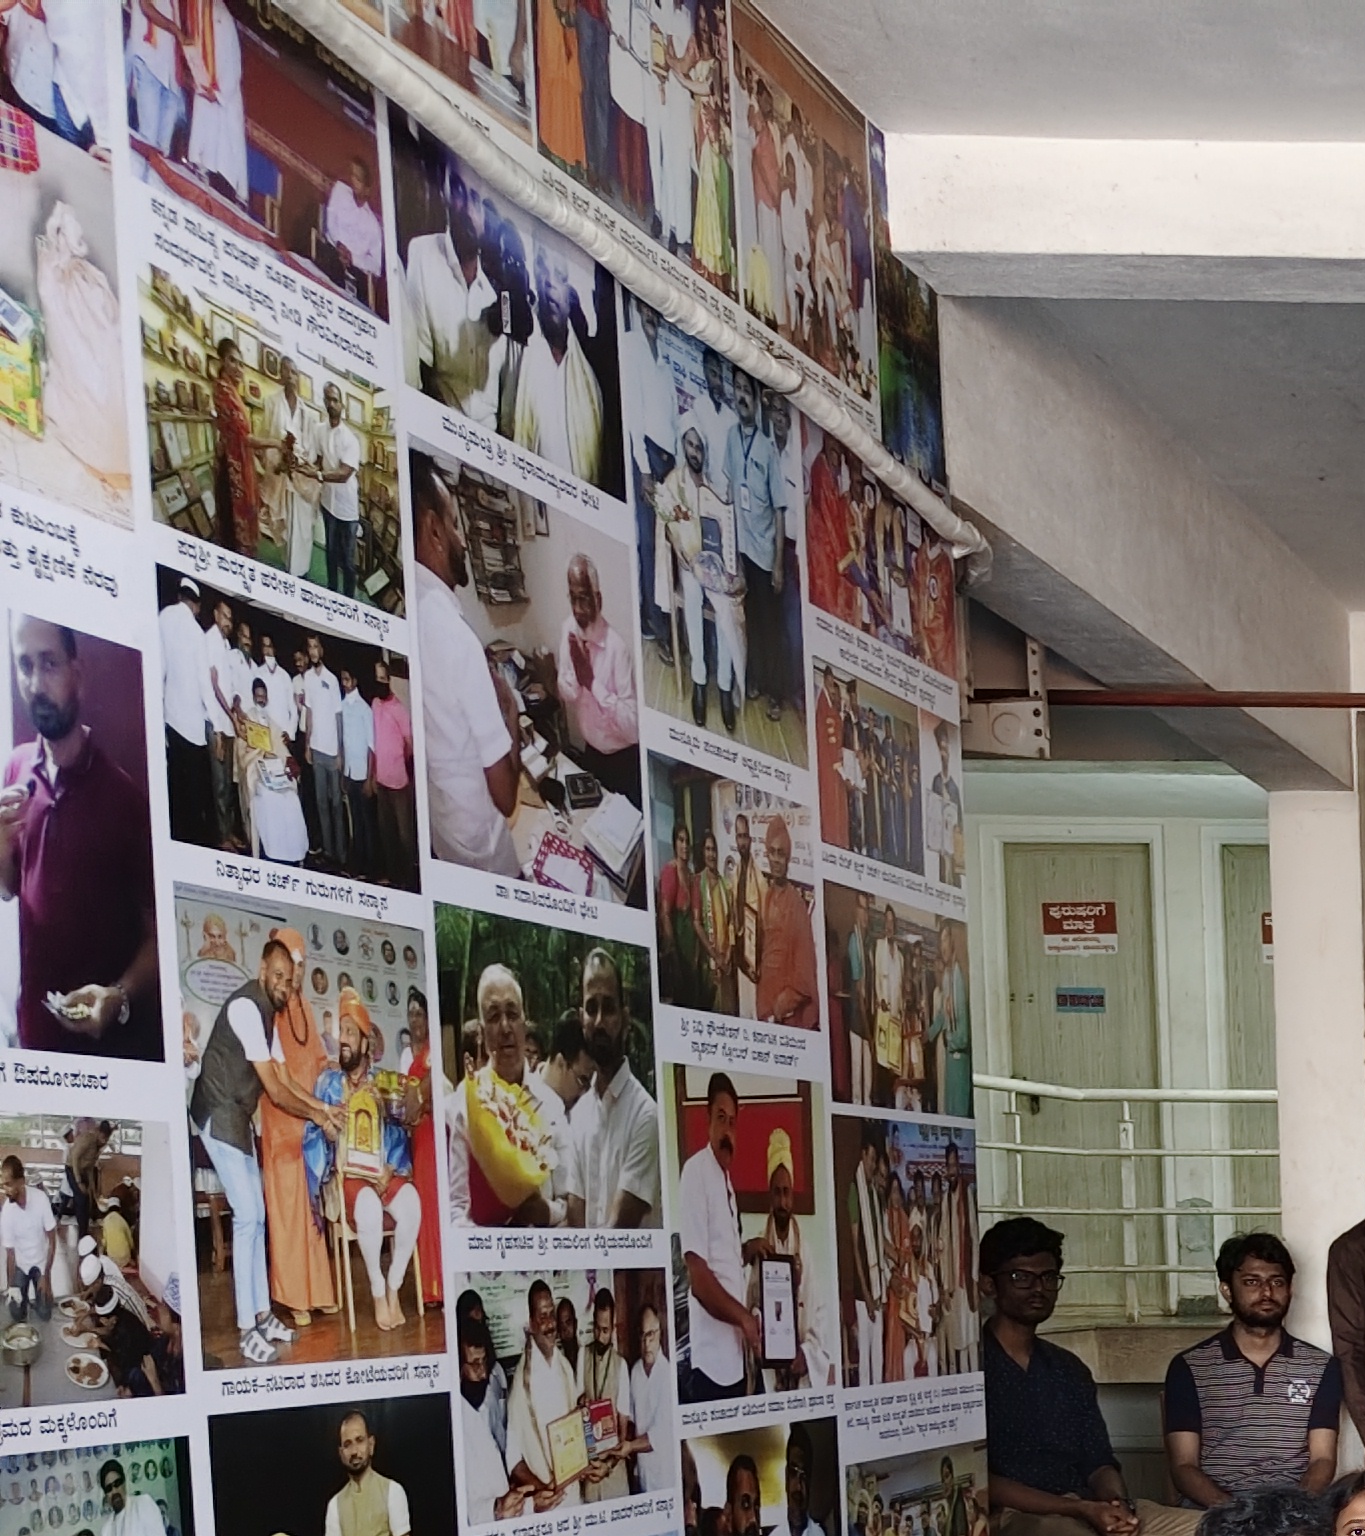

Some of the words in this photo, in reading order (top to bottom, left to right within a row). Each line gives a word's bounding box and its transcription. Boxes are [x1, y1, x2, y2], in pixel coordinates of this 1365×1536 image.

[151, 198, 178, 232] ಕನ್ನಡ
[184, 217, 219, 259] ಸಾಹಿತ್ಯ
[497, 443, 507, 466] ಶ್ರೀ
[11, 506, 79, 558] ಕುಟುಂಬಕ್ಕೆ
[27, 545, 75, 582] ಶೈಕ್ಷಣಿಕ
[83, 565, 118, 598] ನೆರವು
[177, 538, 212, 572] ಪದ್ಮಶ್ರೀ
[363, 610, 390, 642] ಸನ್ಮಾನ
[306, 881, 353, 904] ಗುರುಗಳಿಗೆ
[358, 892, 389, 919] ಸನ್ಮಾನ
[1049, 904, 1107, 919] ಪುರುಷರಿಗೆ
[1063, 919, 1095, 934] ಮಾತ್ರ
[538, 1234, 548, 1255] ಶ್ರೀ
[553, 1234, 591, 1250] ರಾಮಲಿಂಗ
[414, 1362, 440, 1388] ಸನ್ಮಾನ
[39, 1407, 117, 1443] ಮಕ್ಕಳೊಂದಿಗೆ
[573, 1515, 582, 1536] ಶ್ರೀ
